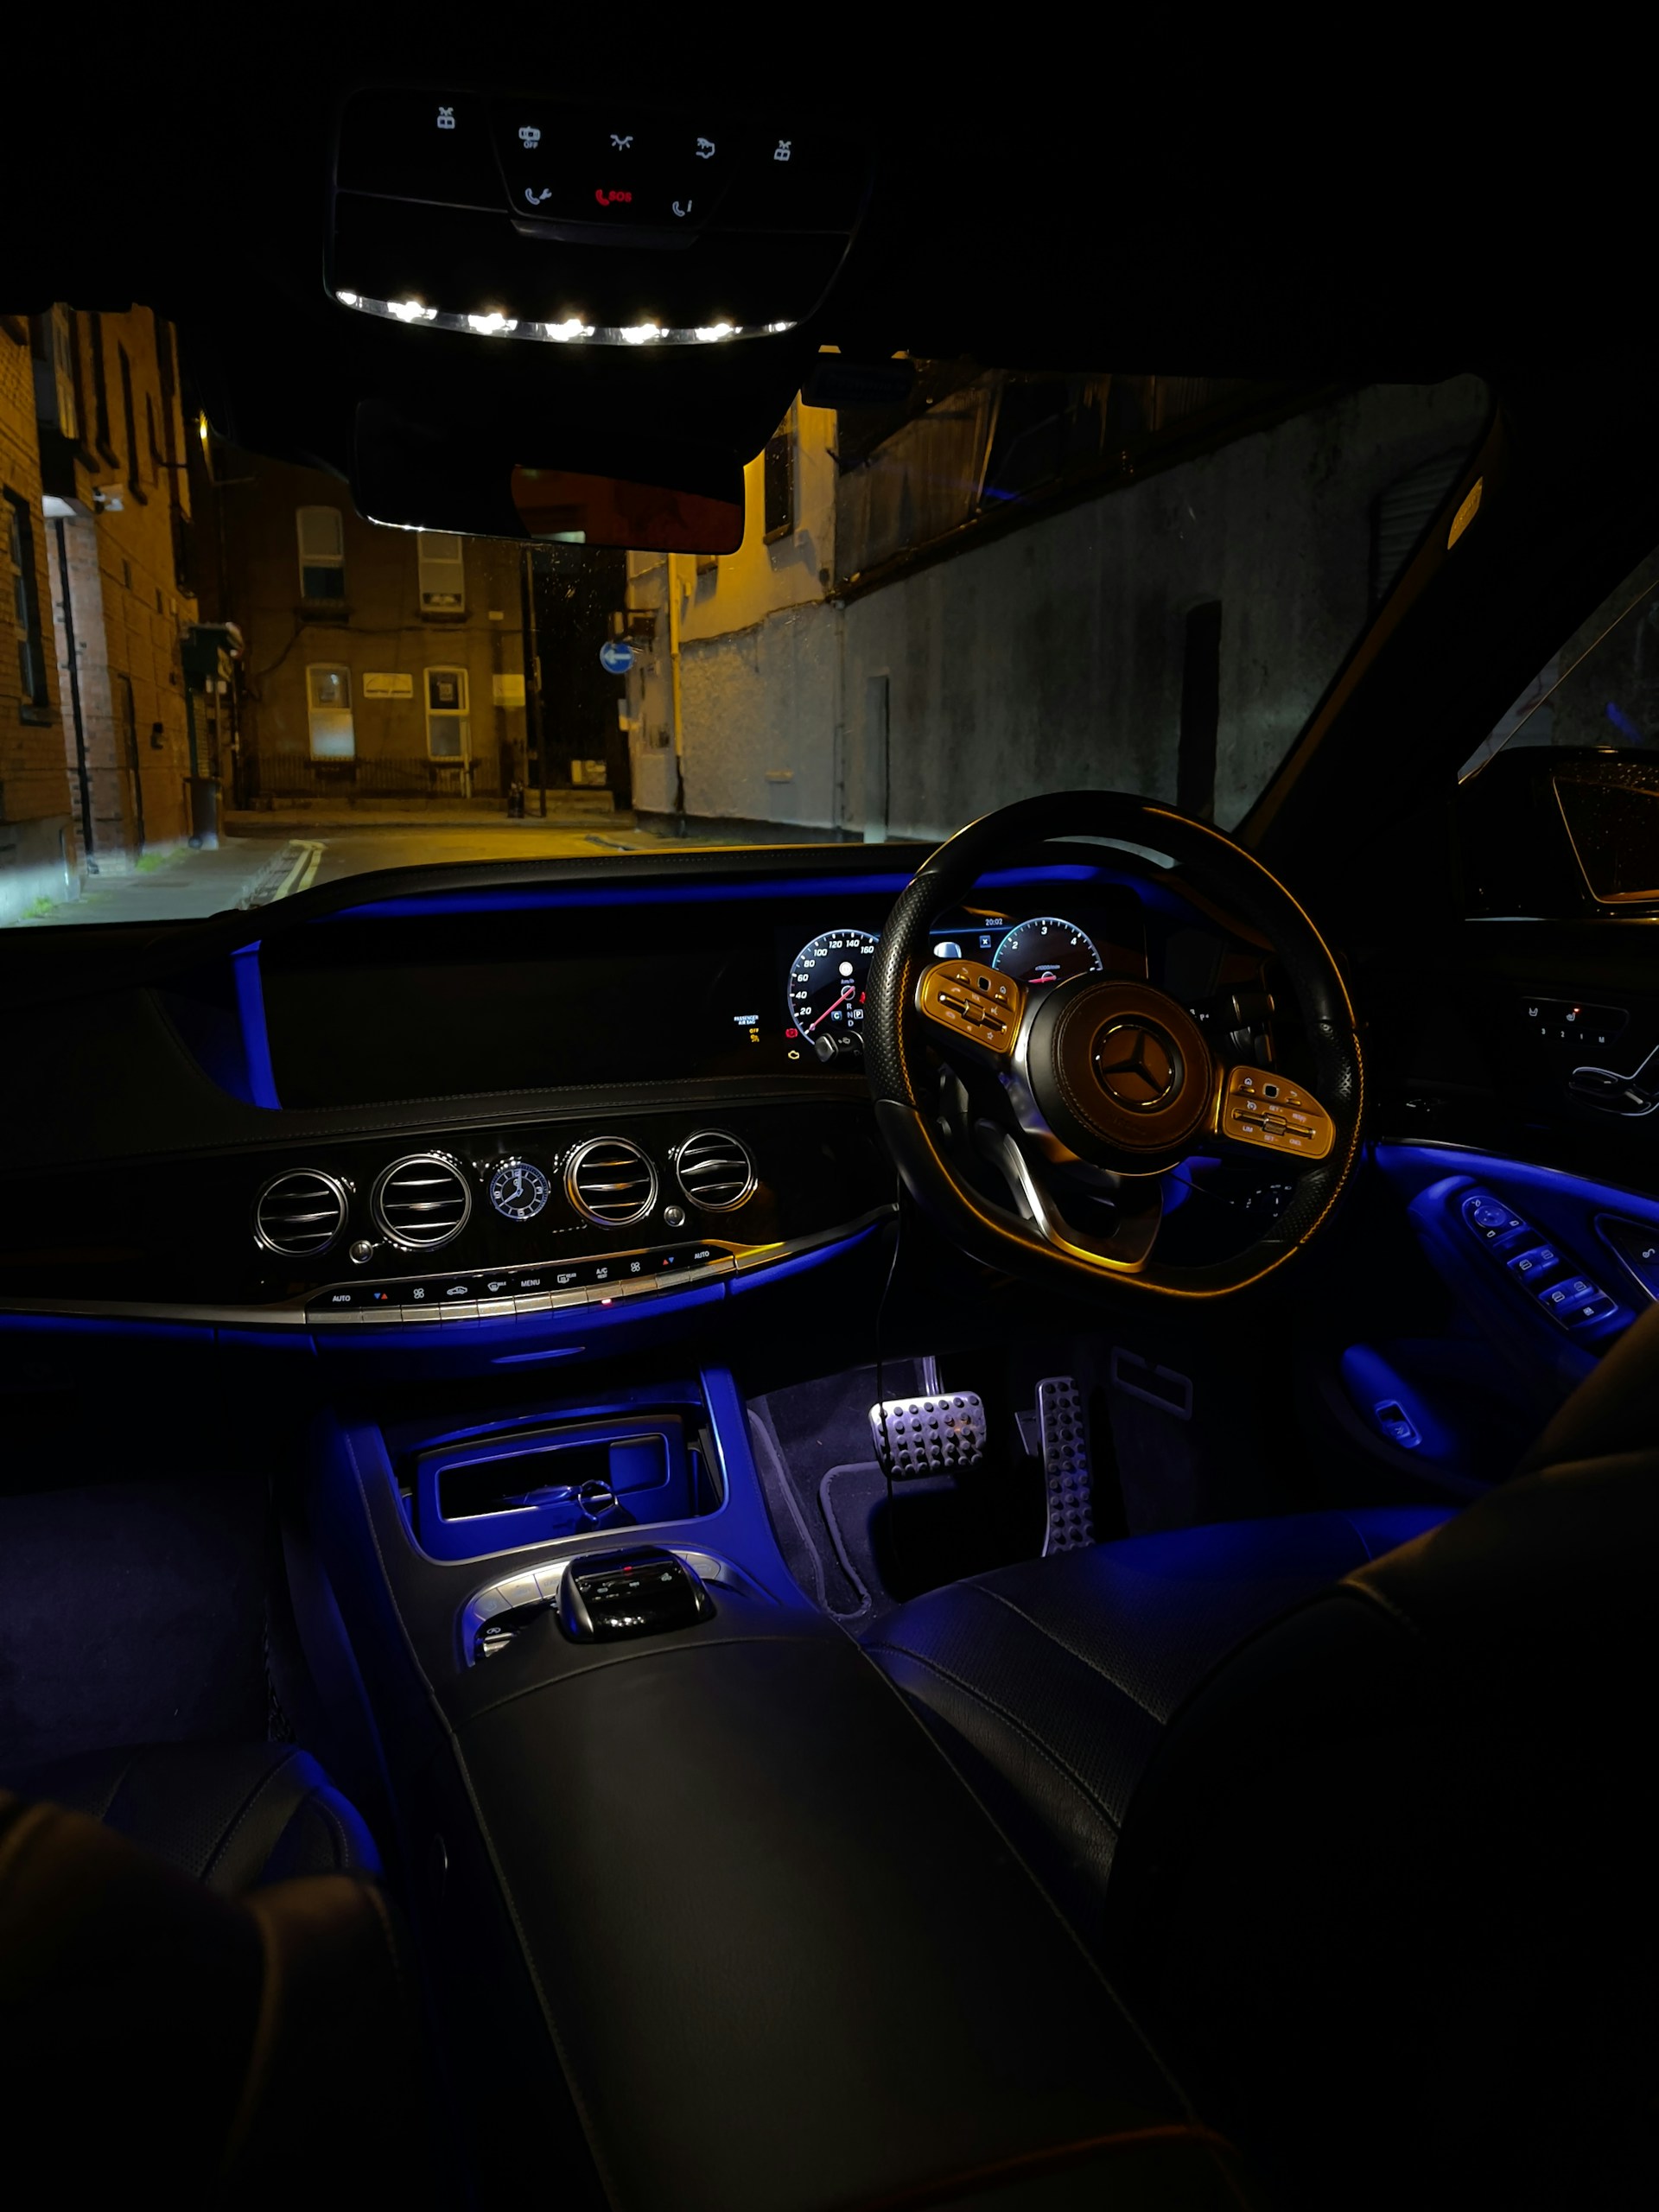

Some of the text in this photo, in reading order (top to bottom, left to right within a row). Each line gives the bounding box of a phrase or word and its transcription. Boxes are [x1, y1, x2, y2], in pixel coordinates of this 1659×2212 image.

[524, 140, 538, 149] OFF
[608, 191, 632, 202] SOS
[985, 918, 1003, 926] 20:02
[1041, 926, 1048, 935] 3
[829, 940, 842, 949] 120
[846, 939, 860, 948] 140
[1012, 940, 1018, 950] 2
[1070, 937, 1077, 945] 4
[861, 945, 874, 954] 160
[797, 974, 809, 982] 60
[695, 1250, 709, 1260] AUTO
[520, 1278, 540, 1287] MENU
